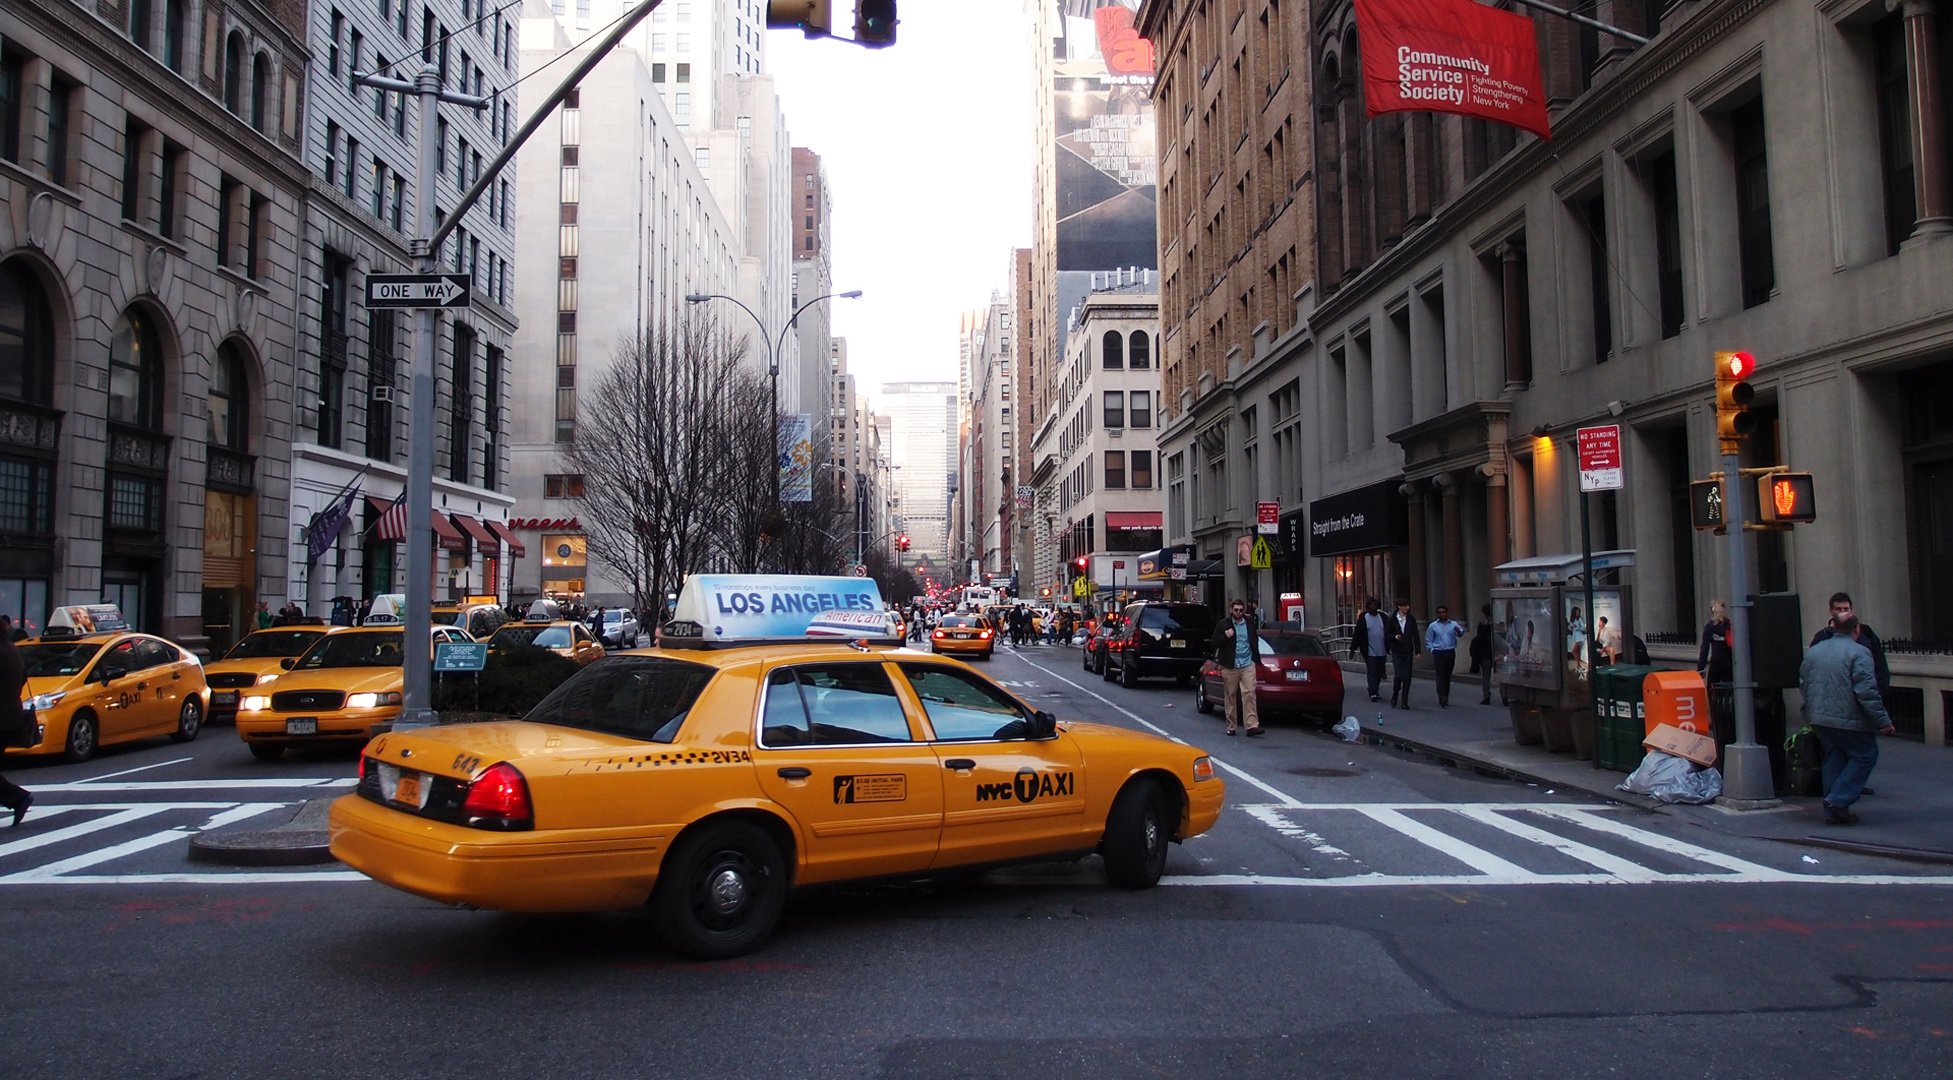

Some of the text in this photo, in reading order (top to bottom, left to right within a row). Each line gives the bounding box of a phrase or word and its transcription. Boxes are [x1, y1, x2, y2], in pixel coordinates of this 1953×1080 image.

[1397, 46, 1490, 75] Community
[1398, 63, 1463, 84] Service
[1400, 81, 1464, 105] Society
[1471, 75, 1529, 96] Fighting Poverty
[1472, 84, 1524, 105] Strengthening
[1473, 95, 1510, 110] New York
[380, 284, 455, 298] ONE WAY
[1590, 430, 1616, 440] STANDING
[1599, 440, 1612, 448] TIME
[1313, 512, 1365, 537] Straight from the Crate
[1289, 519, 1297, 552] WRAPS
[721, 583, 753, 591] nonstops
[716, 592, 875, 614] LOS ANGELES
[825, 610, 882, 625] American
[119, 692, 142, 710] TAXI
[451, 753, 481, 774] 643
[711, 750, 751, 764] 2V34
[976, 768, 1074, 802] NYC TAXI
